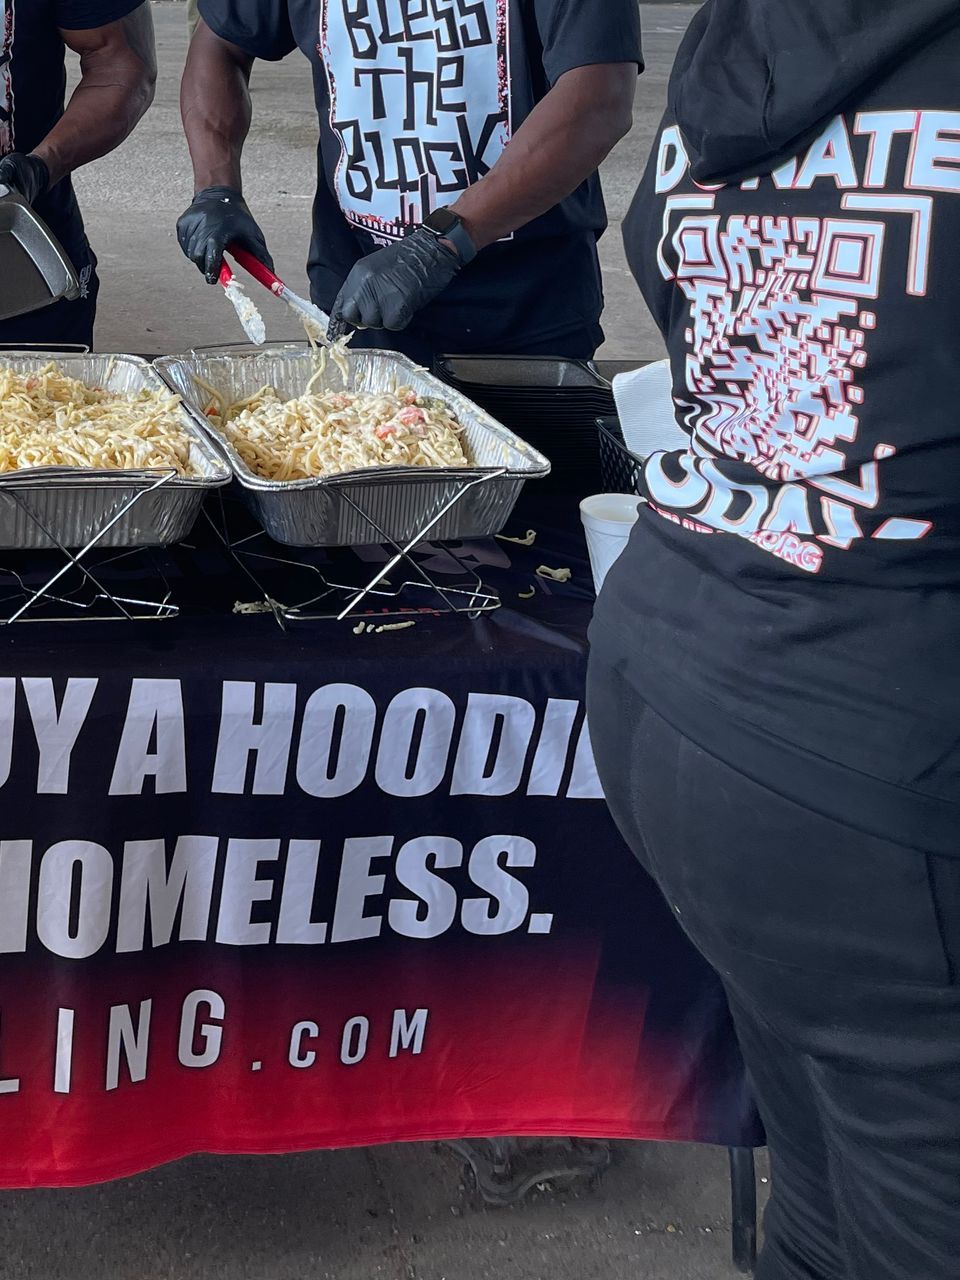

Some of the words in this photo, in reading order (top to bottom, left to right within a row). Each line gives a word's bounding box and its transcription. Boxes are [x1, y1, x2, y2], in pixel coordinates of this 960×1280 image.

[655, 109, 960, 195] DATE
[109, 678, 187, 796] A
[210, 681, 606, 799] HOODI
